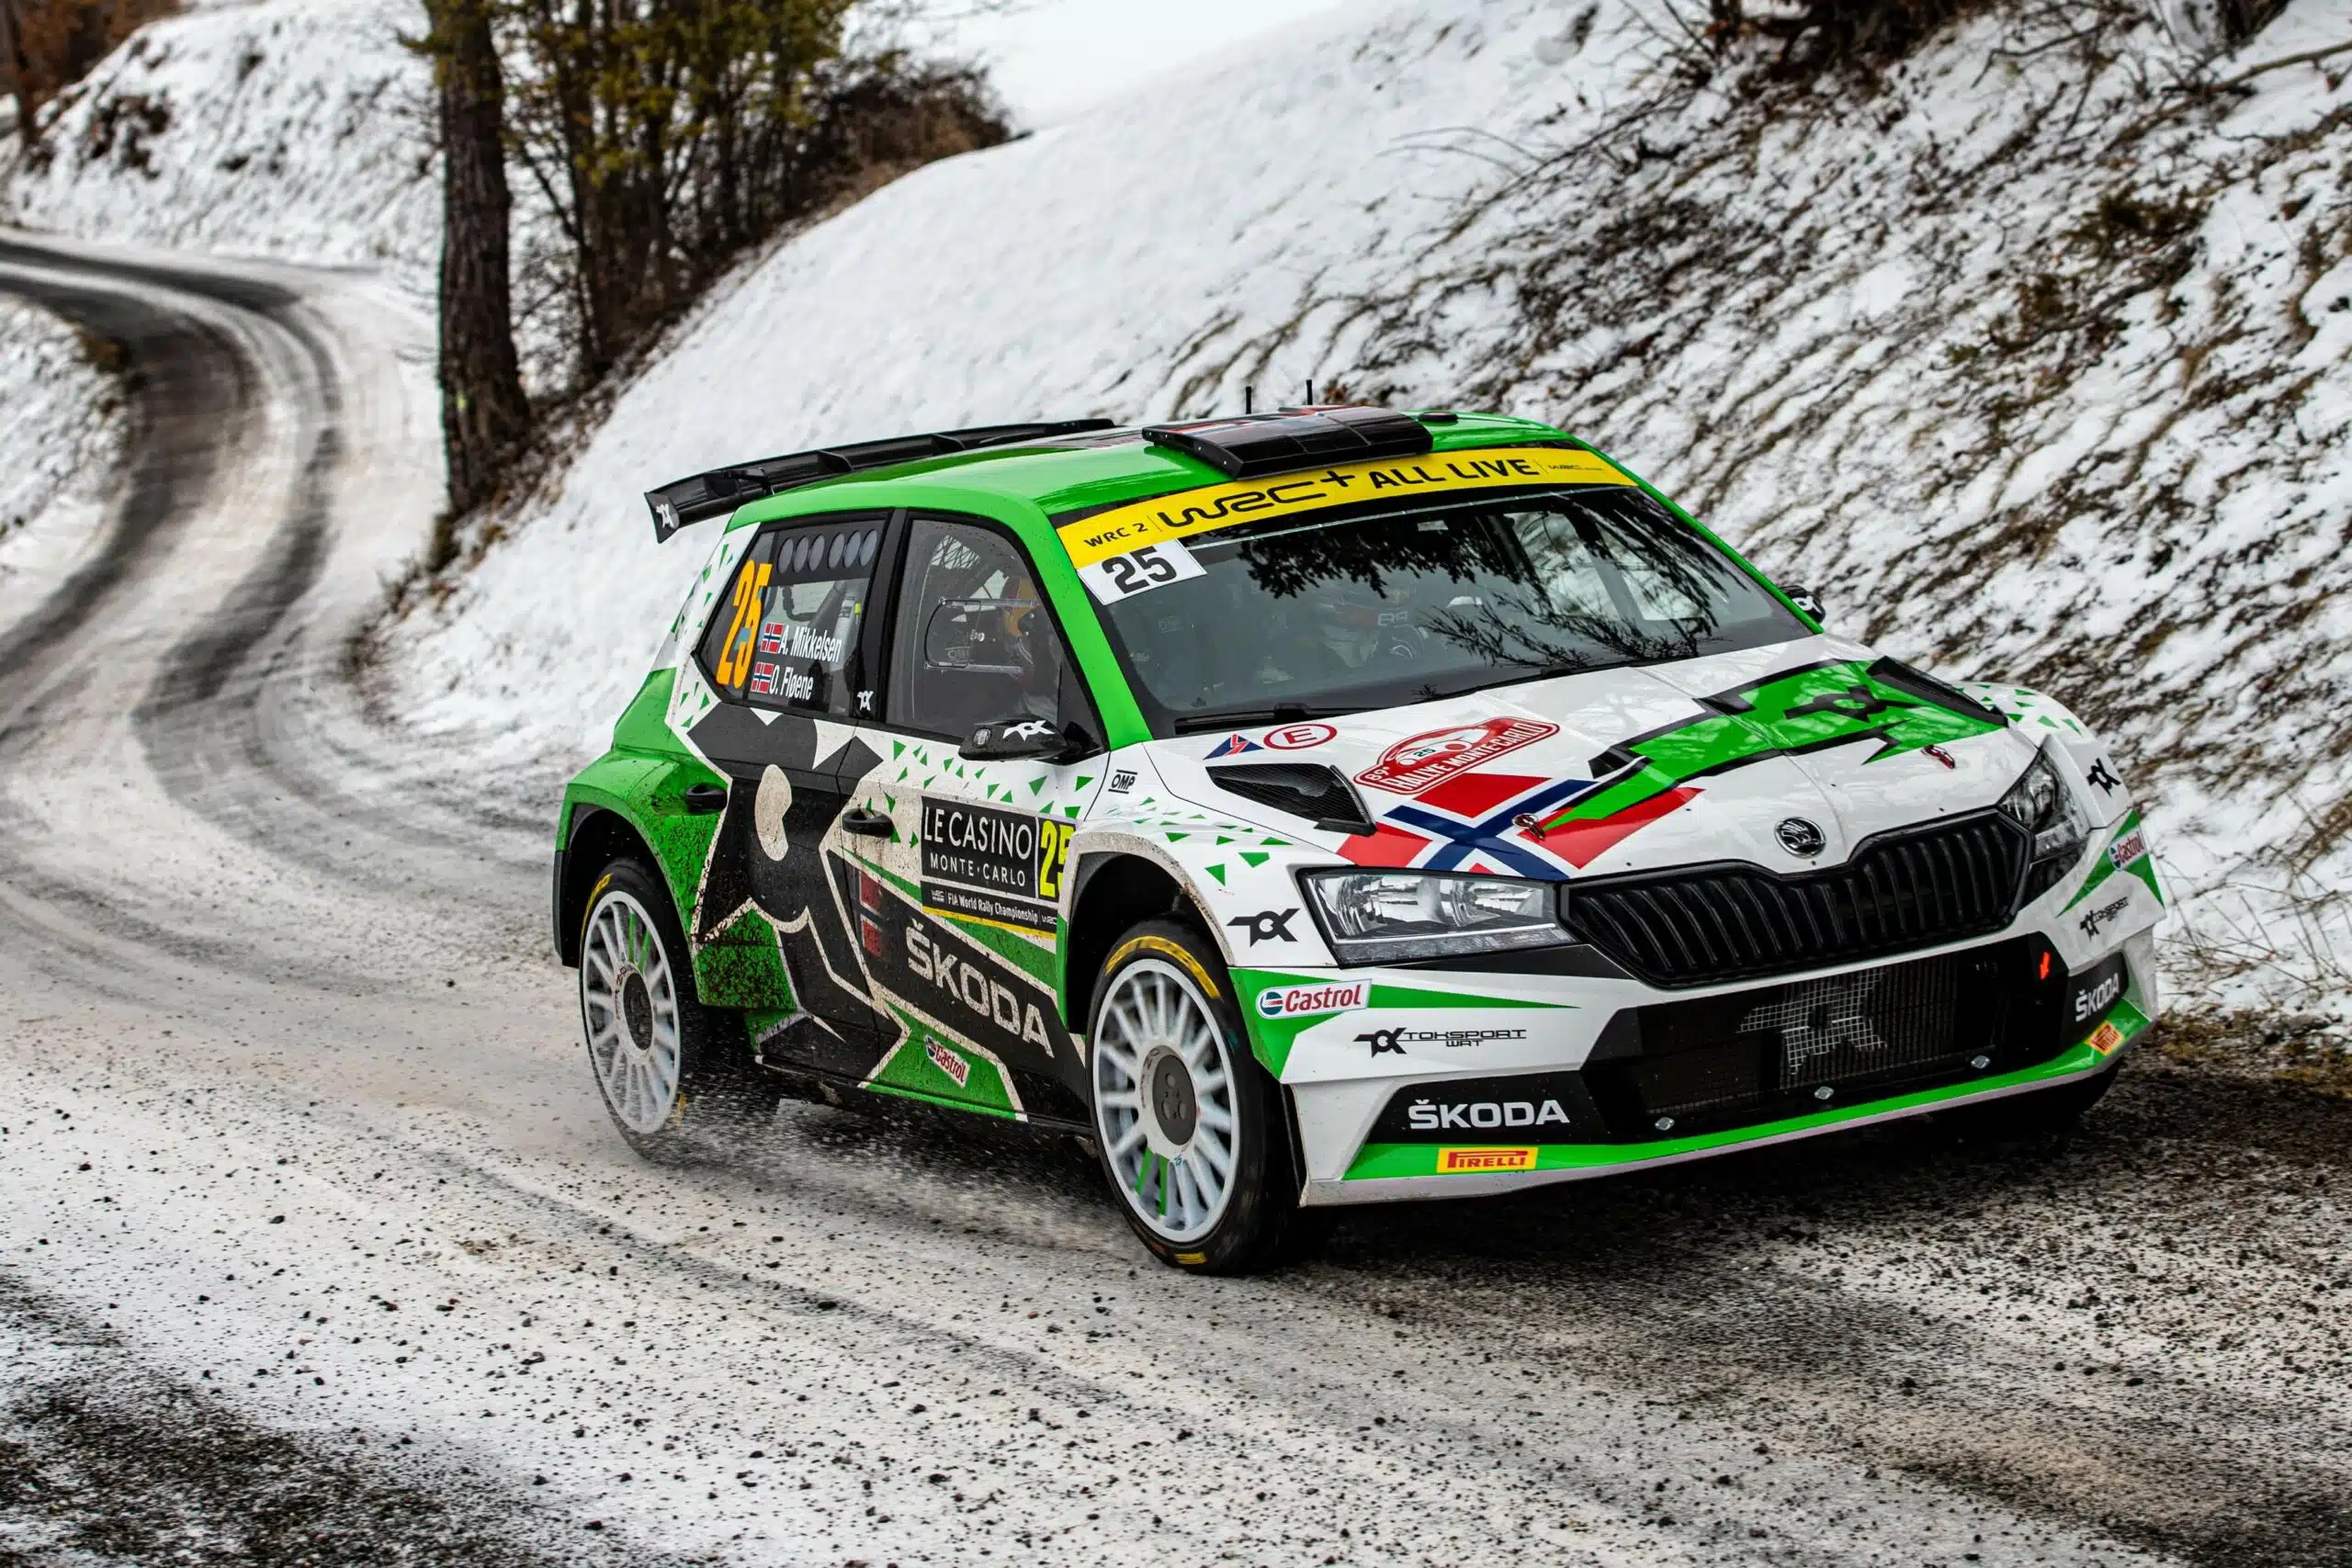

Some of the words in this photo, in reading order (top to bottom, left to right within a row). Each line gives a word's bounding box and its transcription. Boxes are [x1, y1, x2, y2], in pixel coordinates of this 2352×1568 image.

[1084, 526, 1130, 547] WRC
[1133, 523, 1148, 534] 2
[1368, 466, 1446, 489] ALL
[1446, 459, 1540, 479] LIVE
[1102, 546, 1177, 593] 25
[717, 559, 773, 689] 25
[777, 625, 789, 655] A.
[790, 627, 842, 662] Mikkelsen
[769, 664, 778, 694] O.
[780, 666, 814, 701] Fløene
[1283, 728, 1317, 744] E
[1413, 748, 1435, 758] 25
[1111, 773, 1136, 791] OMP
[1384, 762, 1451, 791] RALLYE
[924, 807, 944, 843] LE
[949, 811, 1033, 860] CASINO
[959, 895, 978, 911] World
[978, 899, 993, 916] Rally
[994, 902, 1038, 925] Championship
[905, 918, 1055, 1058] ŠKODA
[1283, 984, 1362, 1013] Castrol
[2075, 973, 2120, 1021] ŠKODA
[1404, 1029, 1527, 1040] TOKSPORT
[936, 1044, 966, 1083] Castrol
[1408, 1099, 1569, 1130] ŠKODA
[1447, 1150, 1527, 1169] PIRELLI
